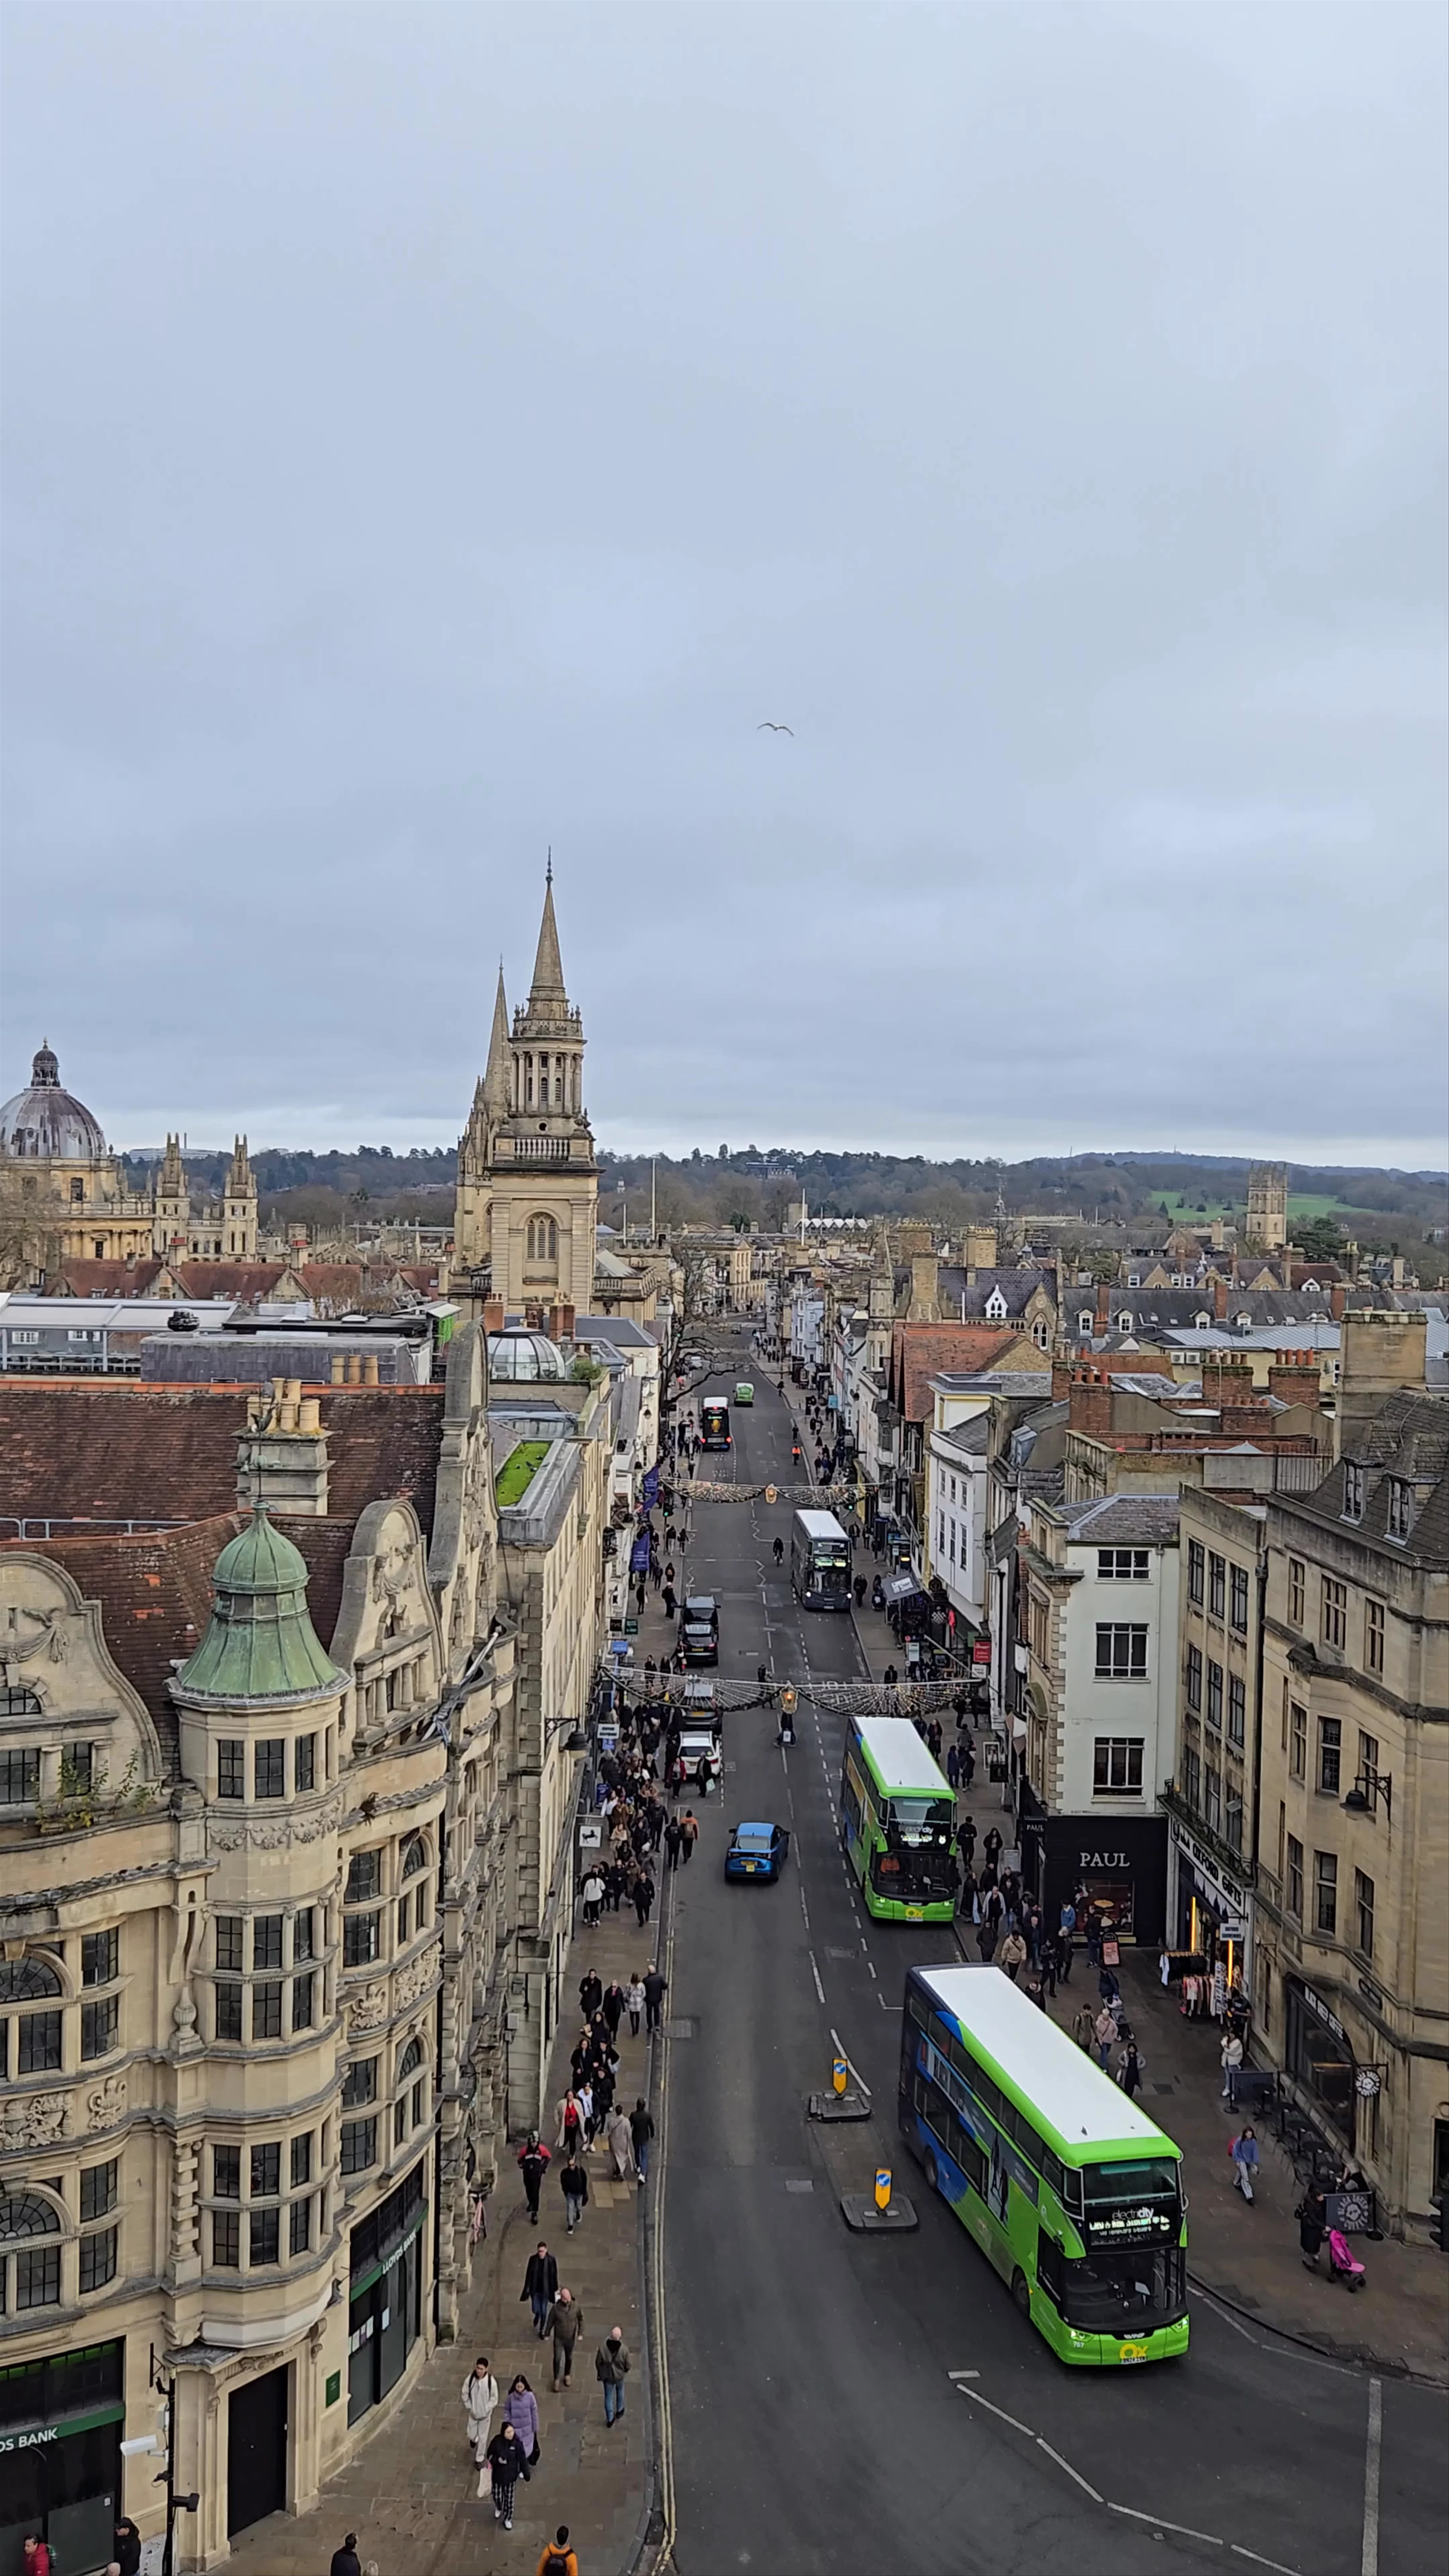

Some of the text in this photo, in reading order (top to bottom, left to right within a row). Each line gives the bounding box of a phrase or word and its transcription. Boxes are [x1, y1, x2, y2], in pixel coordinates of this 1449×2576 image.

[1080, 1852, 1130, 1867] PAUL
[1192, 1842, 1242, 1907] OXFORD GIFTS
[1112, 2206, 1154, 2221] electricity
[382, 2228, 417, 2275] LLOYDS BANK
[18, 2427, 58, 2448] BANK
